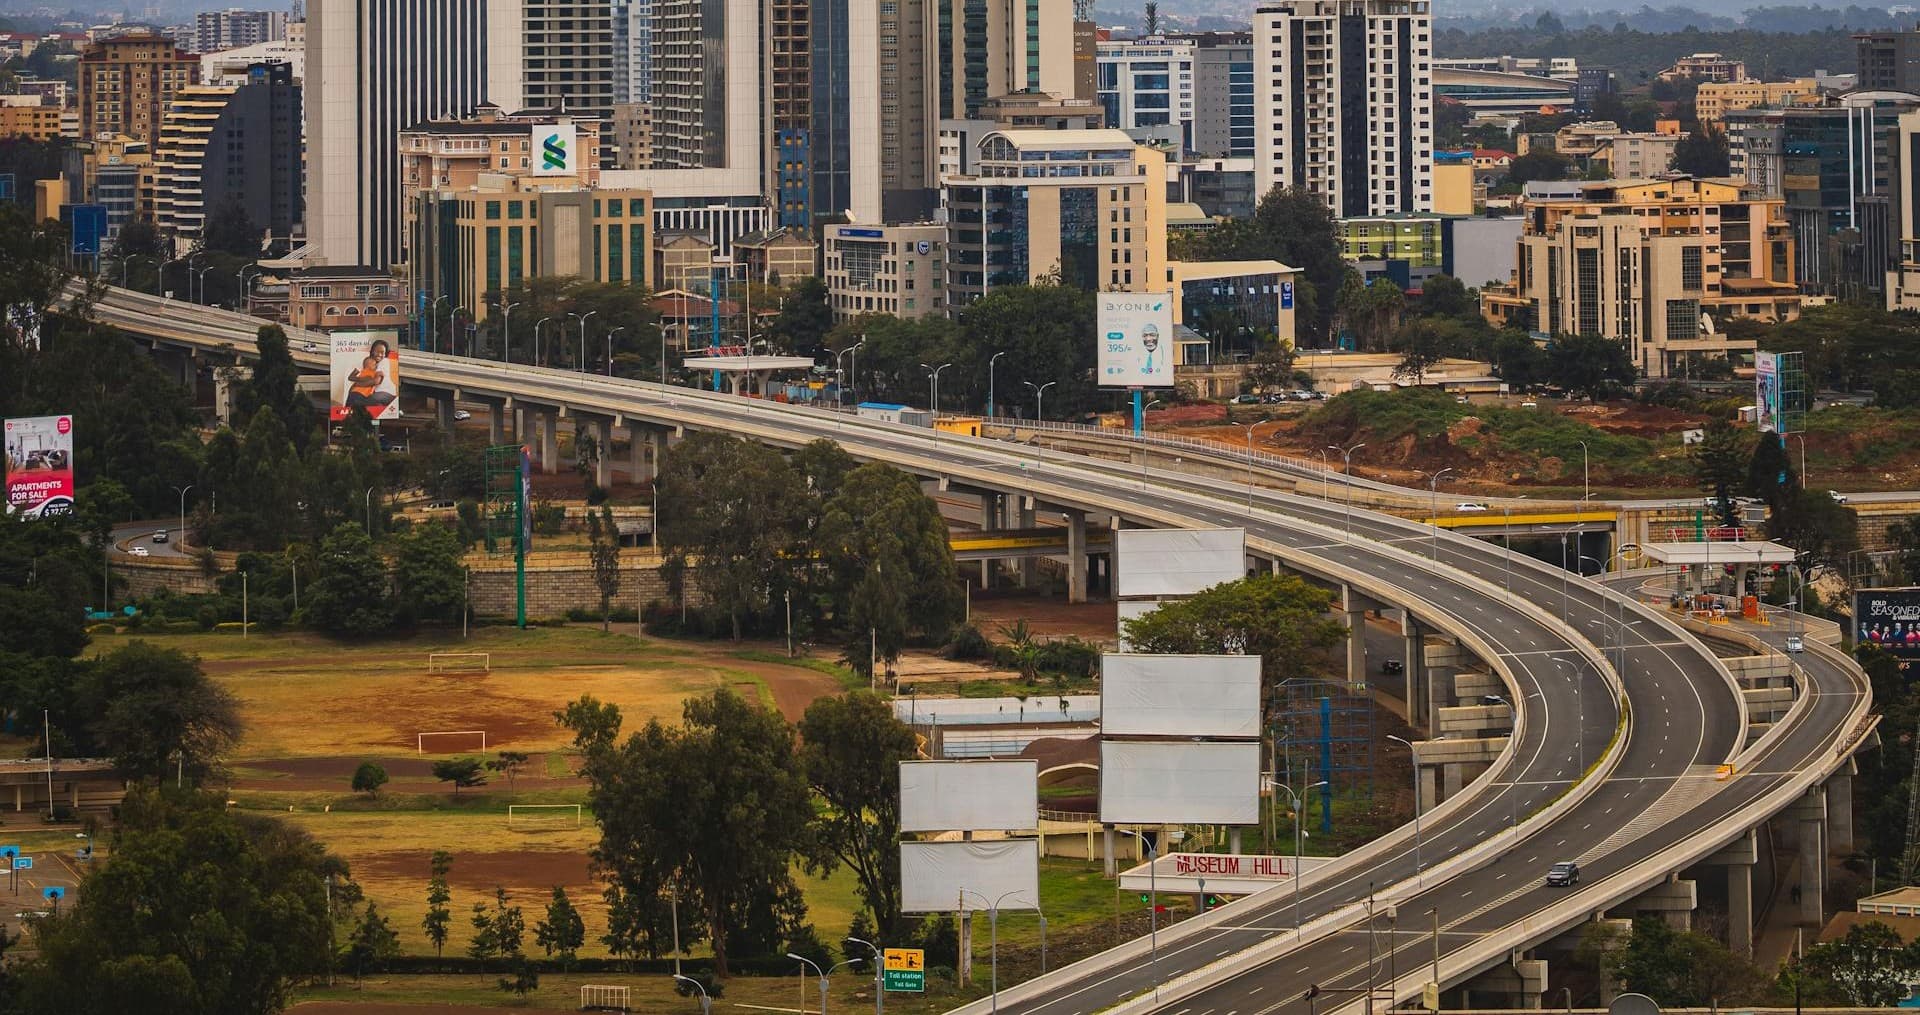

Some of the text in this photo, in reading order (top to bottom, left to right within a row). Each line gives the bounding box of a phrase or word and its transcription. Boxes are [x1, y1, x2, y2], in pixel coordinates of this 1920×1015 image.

[348, 340, 362, 348] days
[11, 480, 62, 492] APARTMENTS
[11, 490, 48, 500] FOR SALE
[1870, 605, 1920, 616] SEASONED
[1177, 856, 1289, 875] MUSEUM HILL
[901, 972, 922, 980] station
